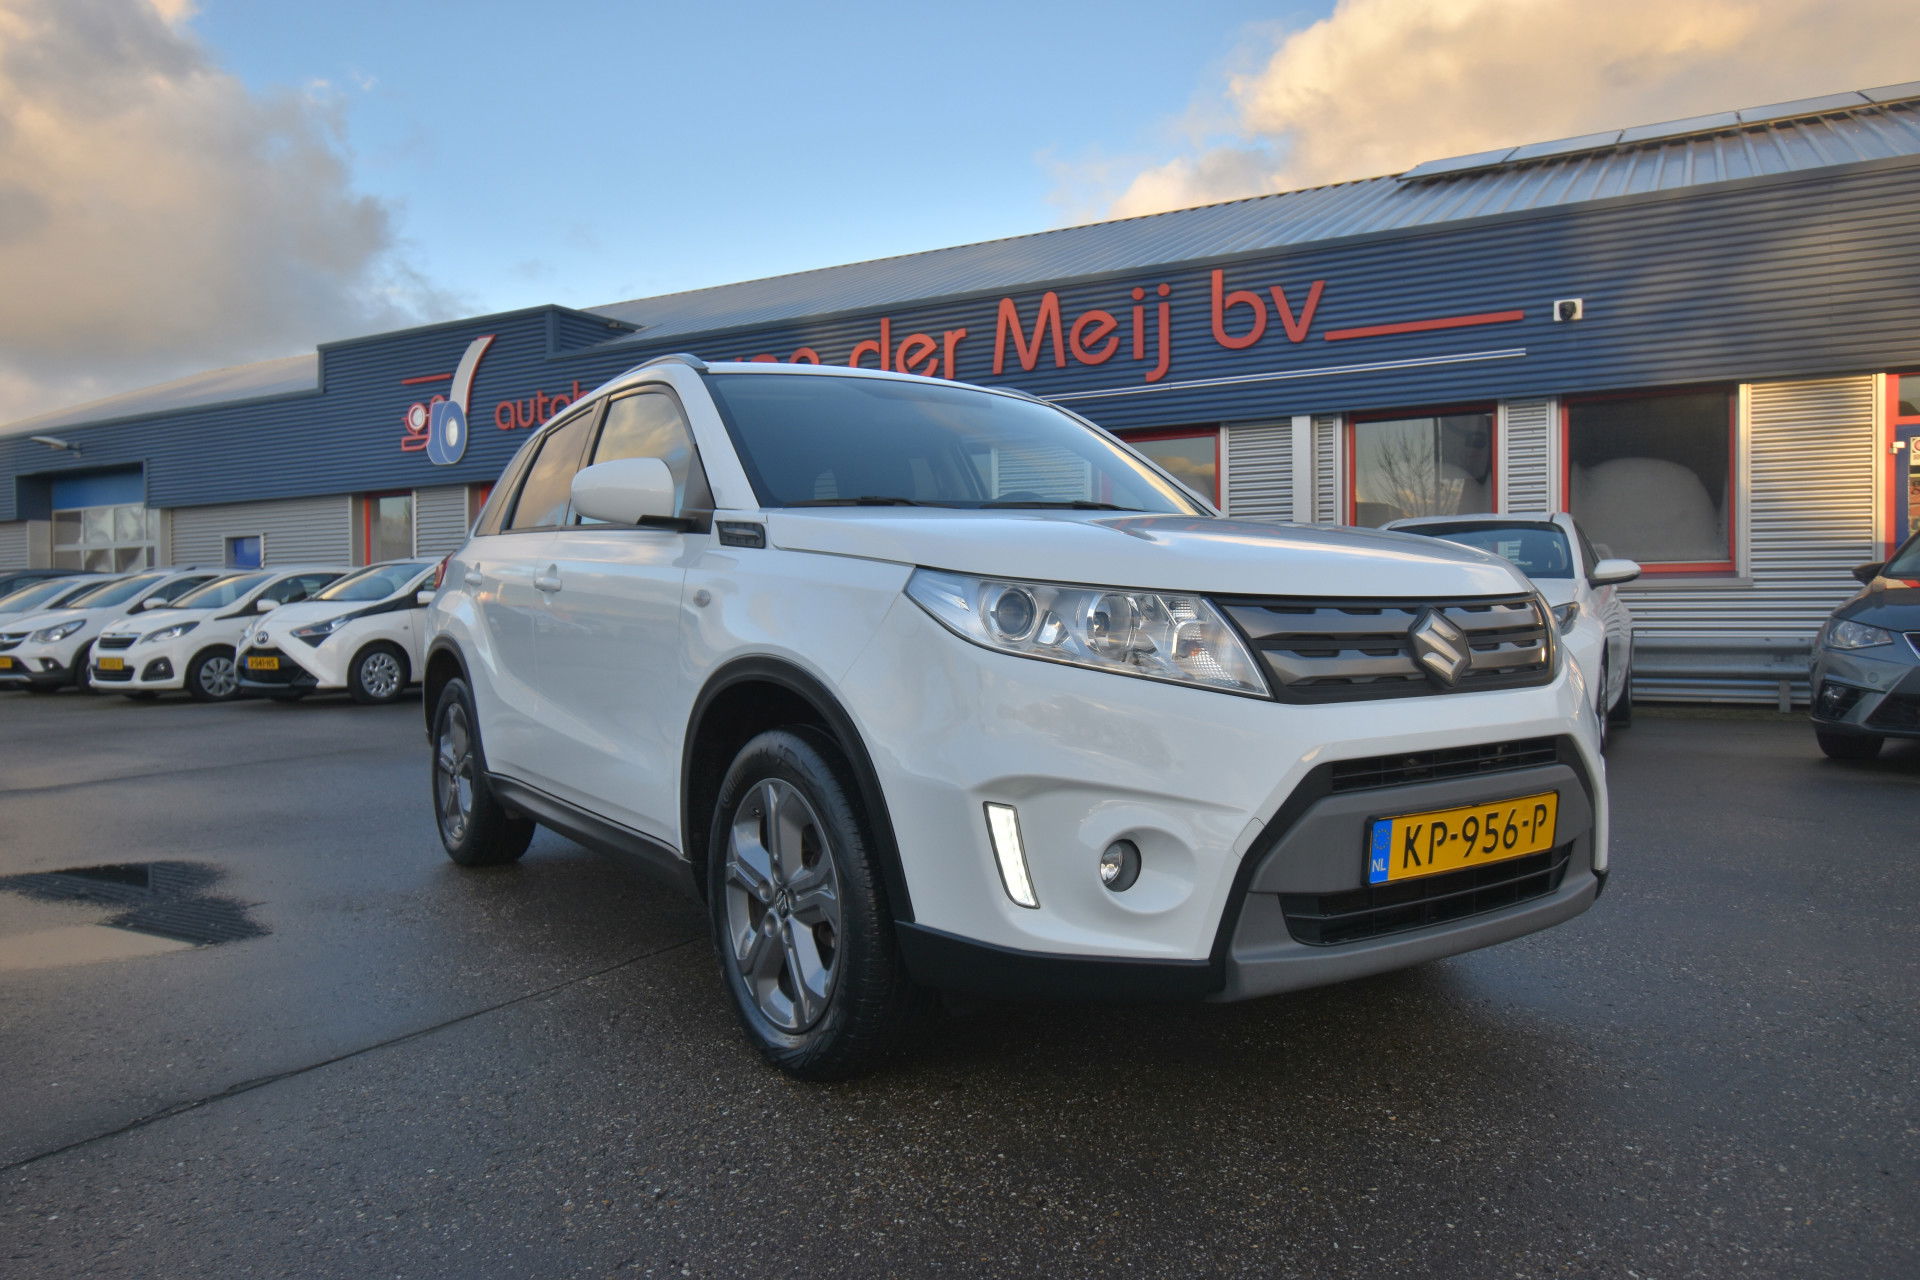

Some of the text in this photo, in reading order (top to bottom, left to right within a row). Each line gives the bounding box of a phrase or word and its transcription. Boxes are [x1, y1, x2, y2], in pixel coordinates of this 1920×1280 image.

[849, 269, 1326, 383] der Meij bv
[1371, 858, 1387, 873] NL
[1403, 803, 1548, 869] KP-956-P
